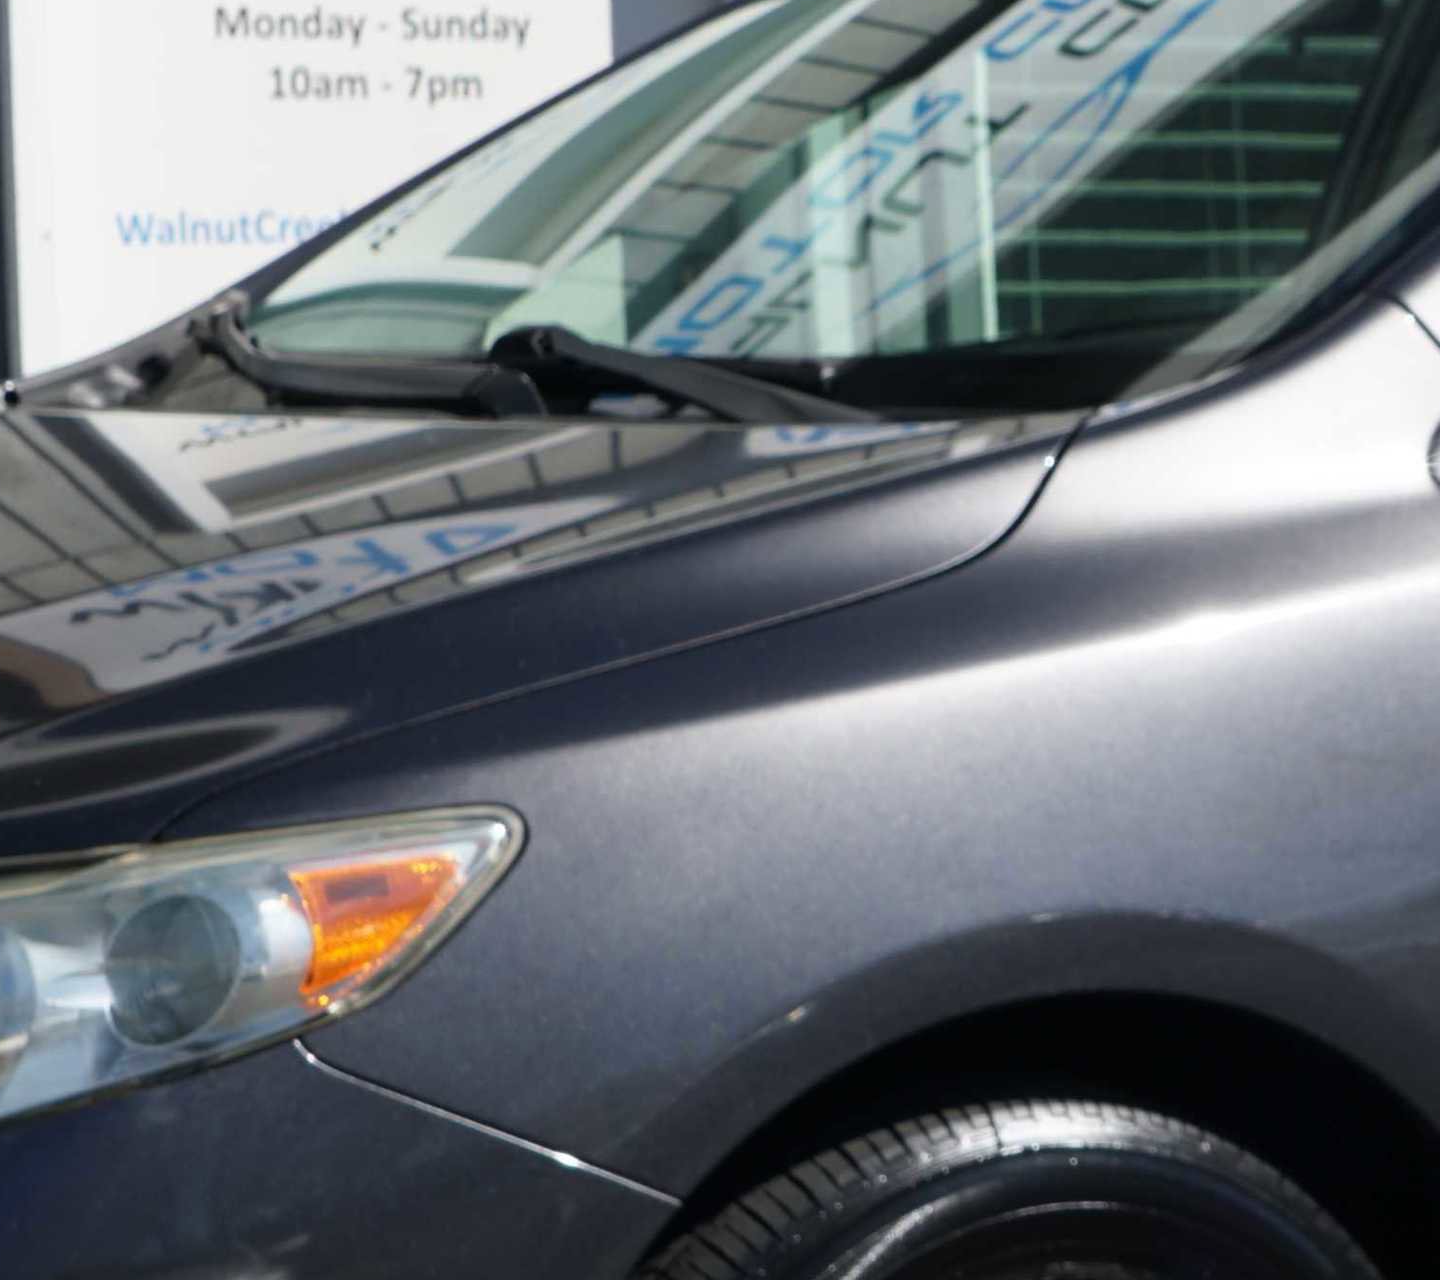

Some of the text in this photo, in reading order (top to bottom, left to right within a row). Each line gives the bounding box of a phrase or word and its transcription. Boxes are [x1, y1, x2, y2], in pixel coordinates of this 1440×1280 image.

[214, 6, 366, 47] Monday
[401, 7, 532, 48] Sunday
[270, 66, 370, 101] 10am
[406, 67, 485, 108] 7pm
